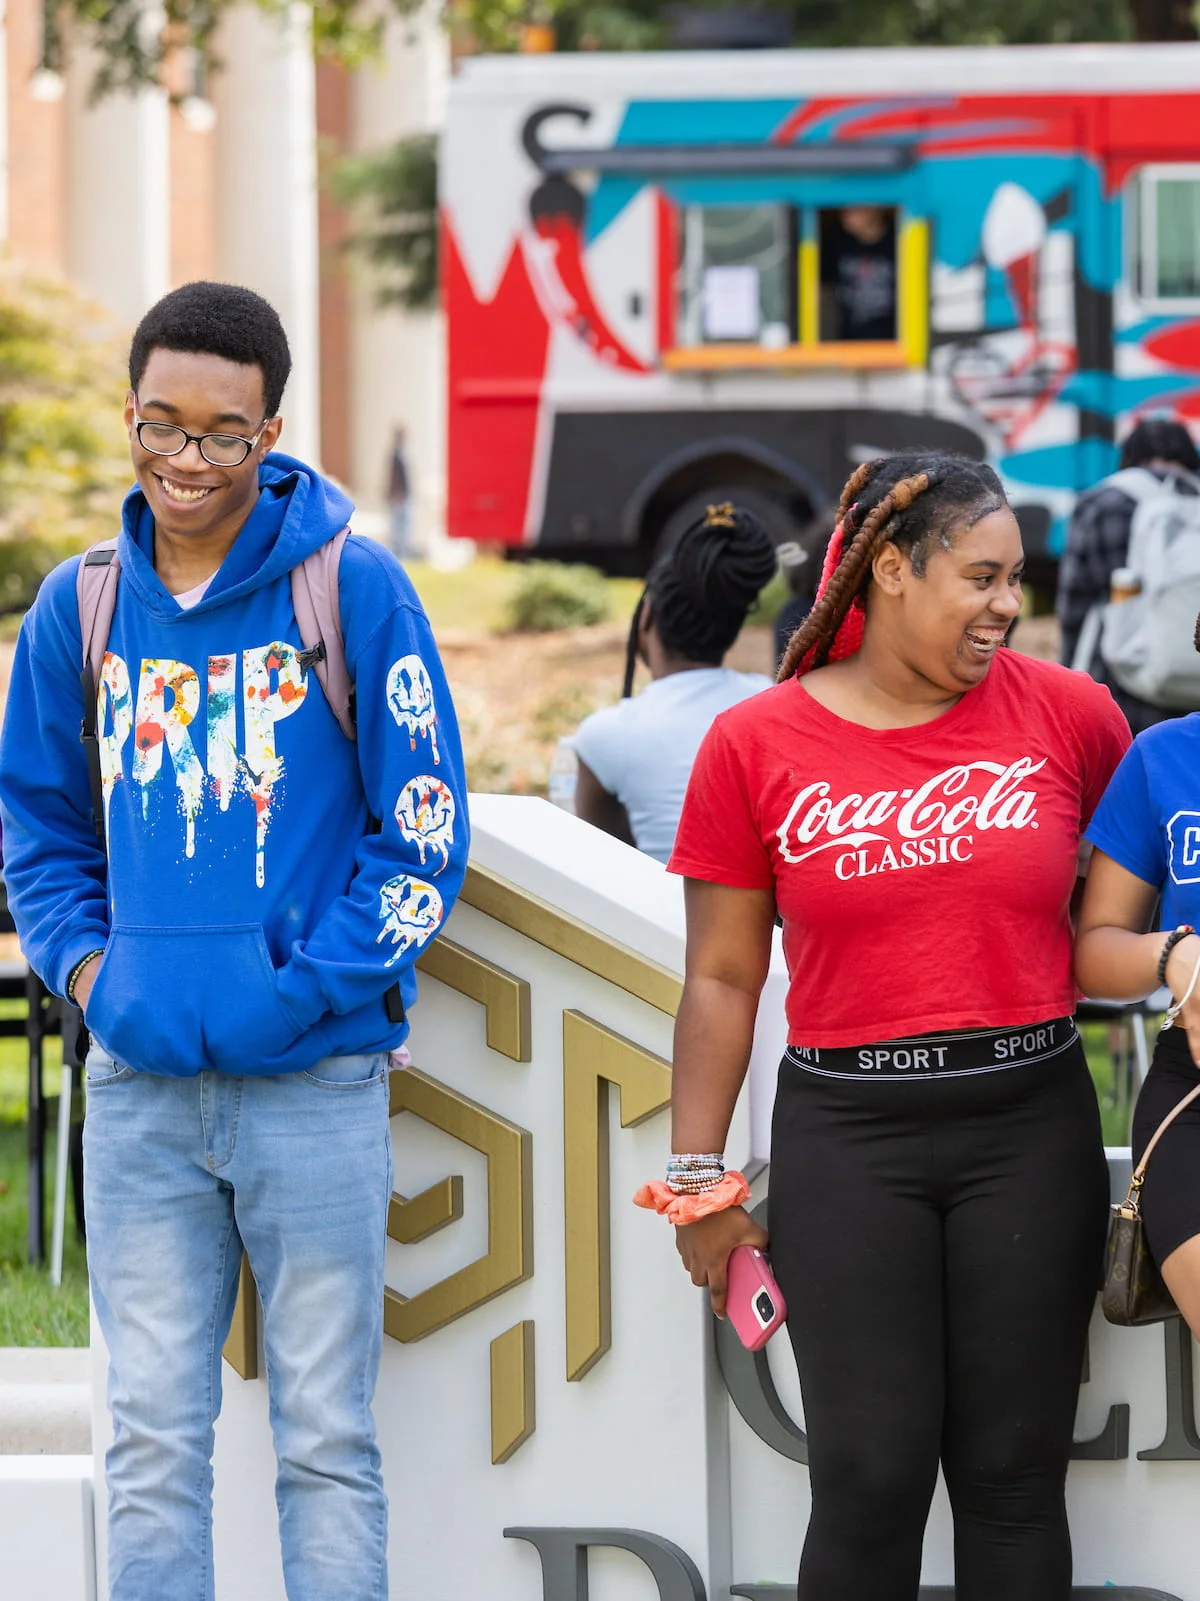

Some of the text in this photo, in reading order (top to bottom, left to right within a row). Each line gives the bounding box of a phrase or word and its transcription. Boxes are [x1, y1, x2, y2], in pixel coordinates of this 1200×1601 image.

[96, 640, 309, 889] DRIP
[776, 756, 1048, 864] Coca-Cola
[835, 834, 974, 881] CLASSIC
[858, 1046, 949, 1071] SPORT
[993, 1024, 1057, 1060] SPORT
